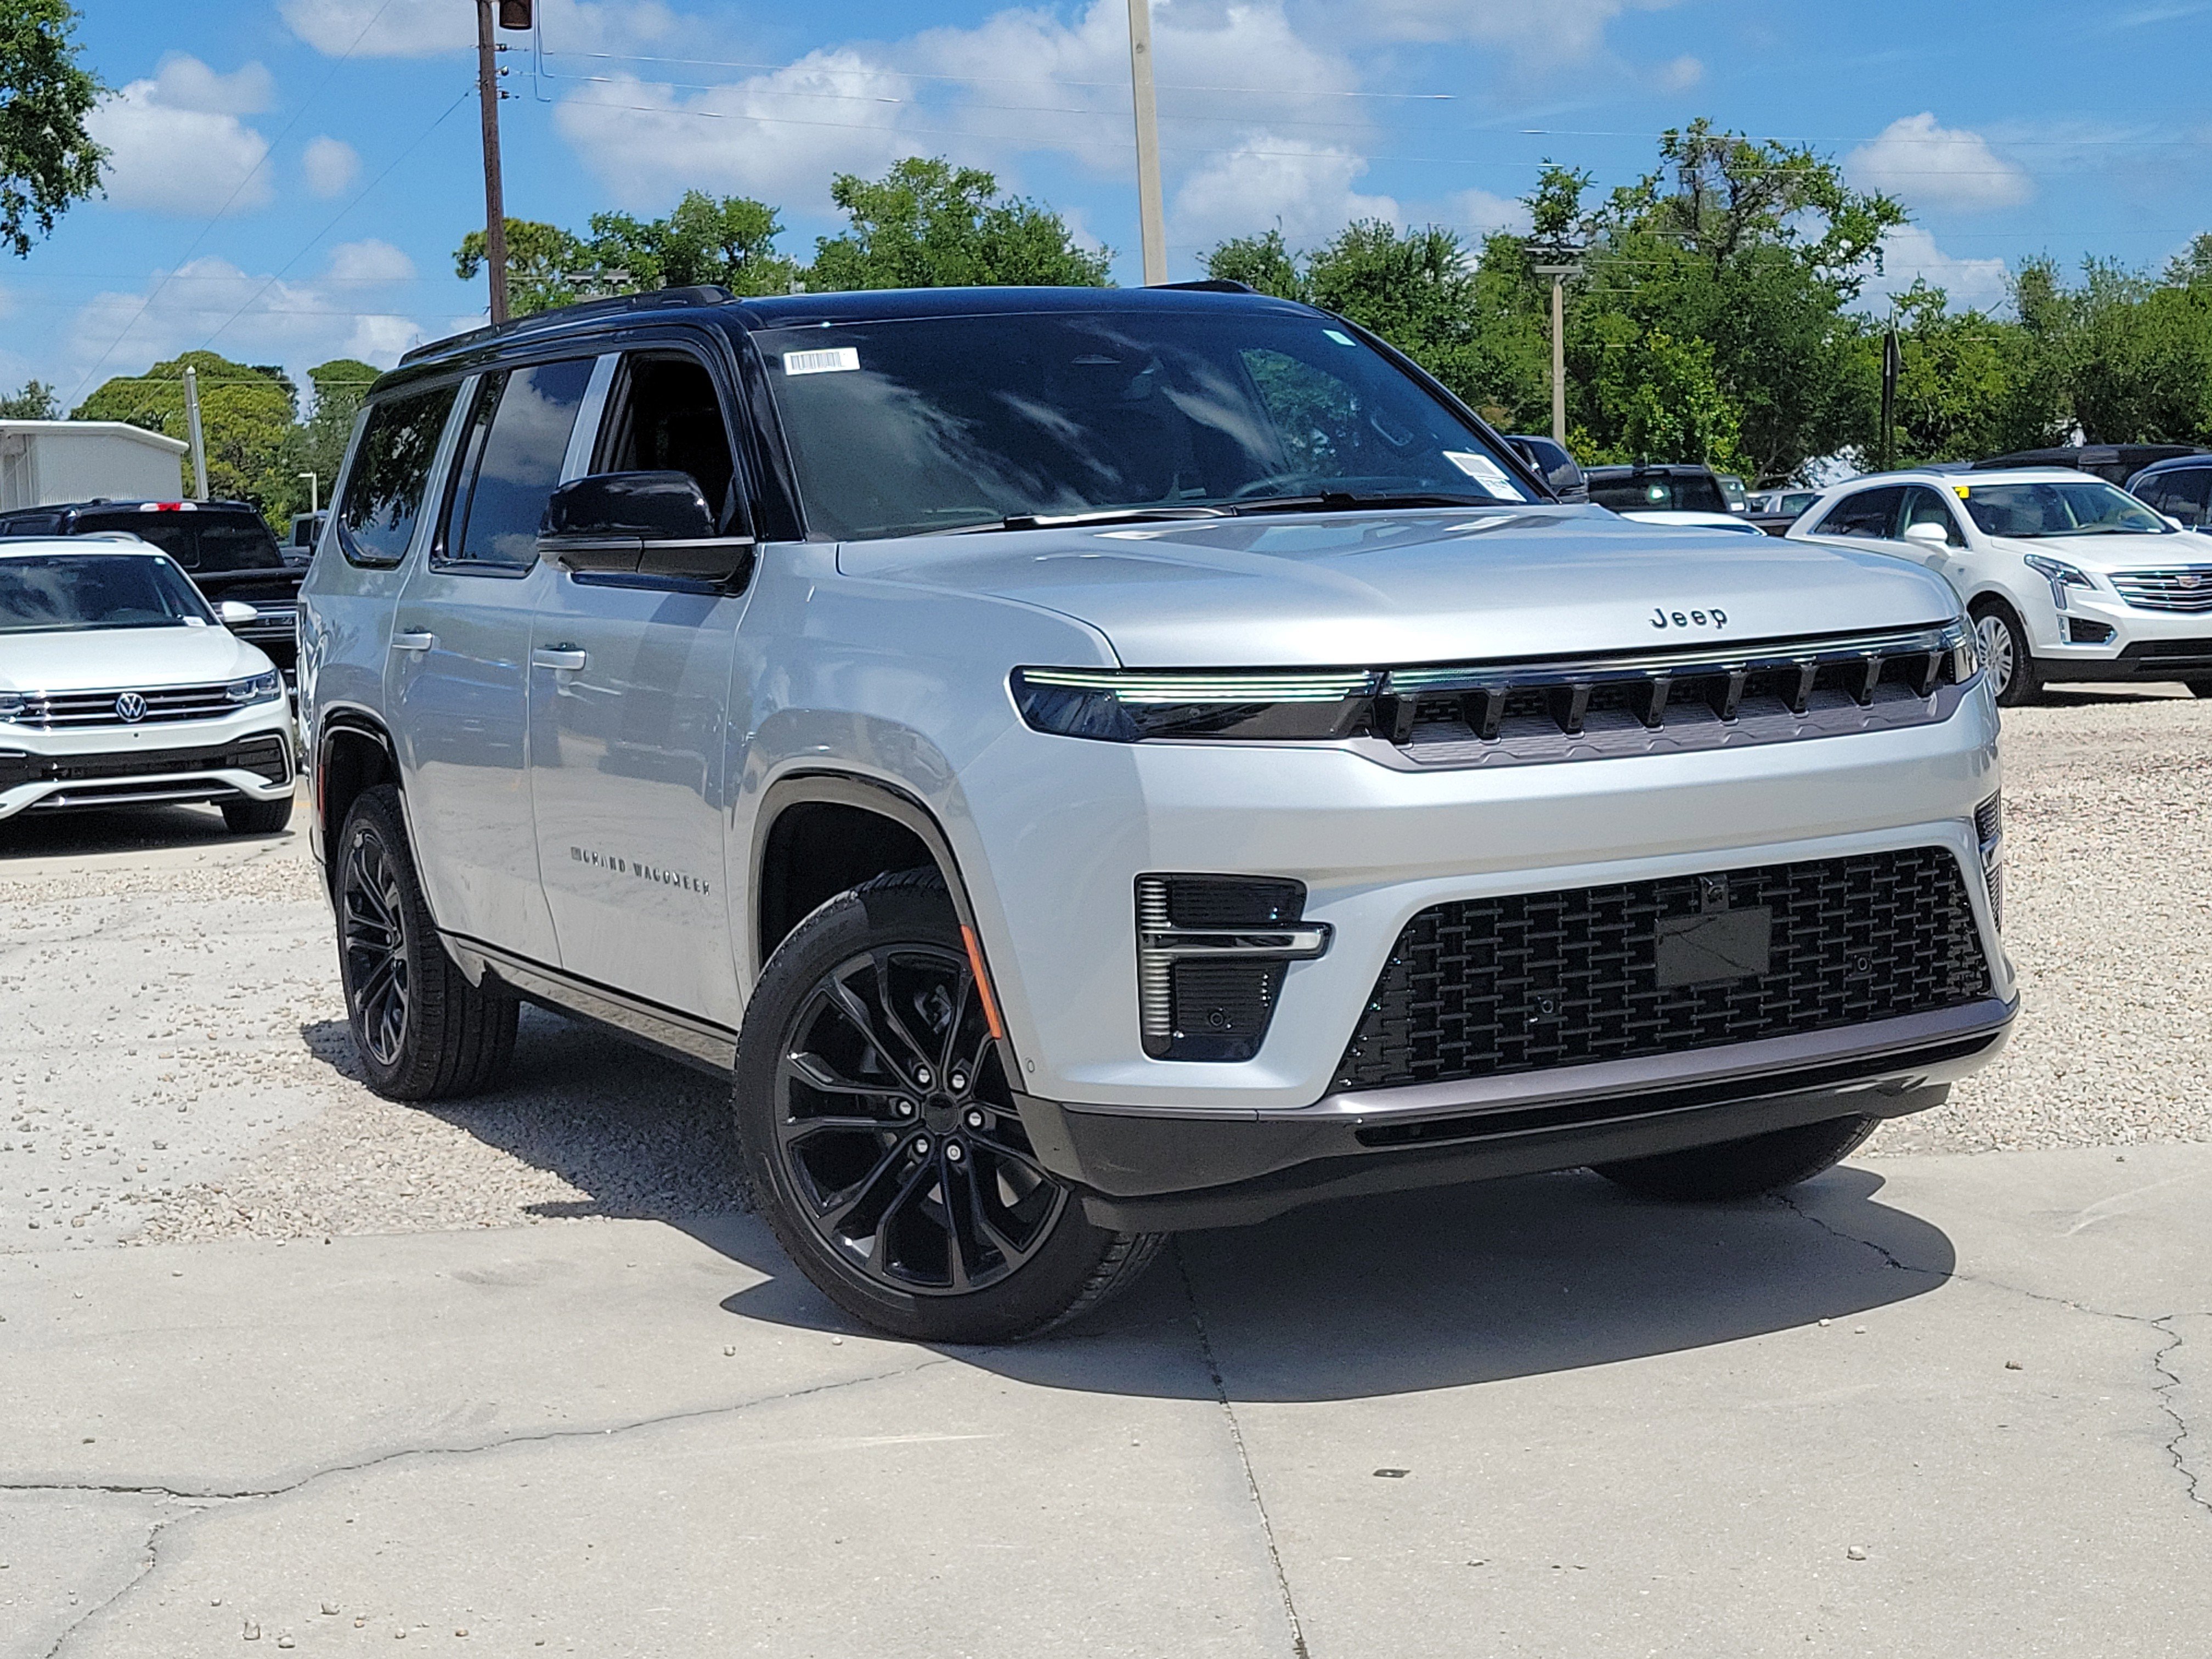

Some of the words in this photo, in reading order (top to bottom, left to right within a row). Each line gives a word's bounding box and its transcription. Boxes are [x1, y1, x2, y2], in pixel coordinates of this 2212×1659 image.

[1649, 608, 1728, 630] Jeep
[583, 850, 626, 873] GRAND
[633, 862, 710, 896] WAGONEER
